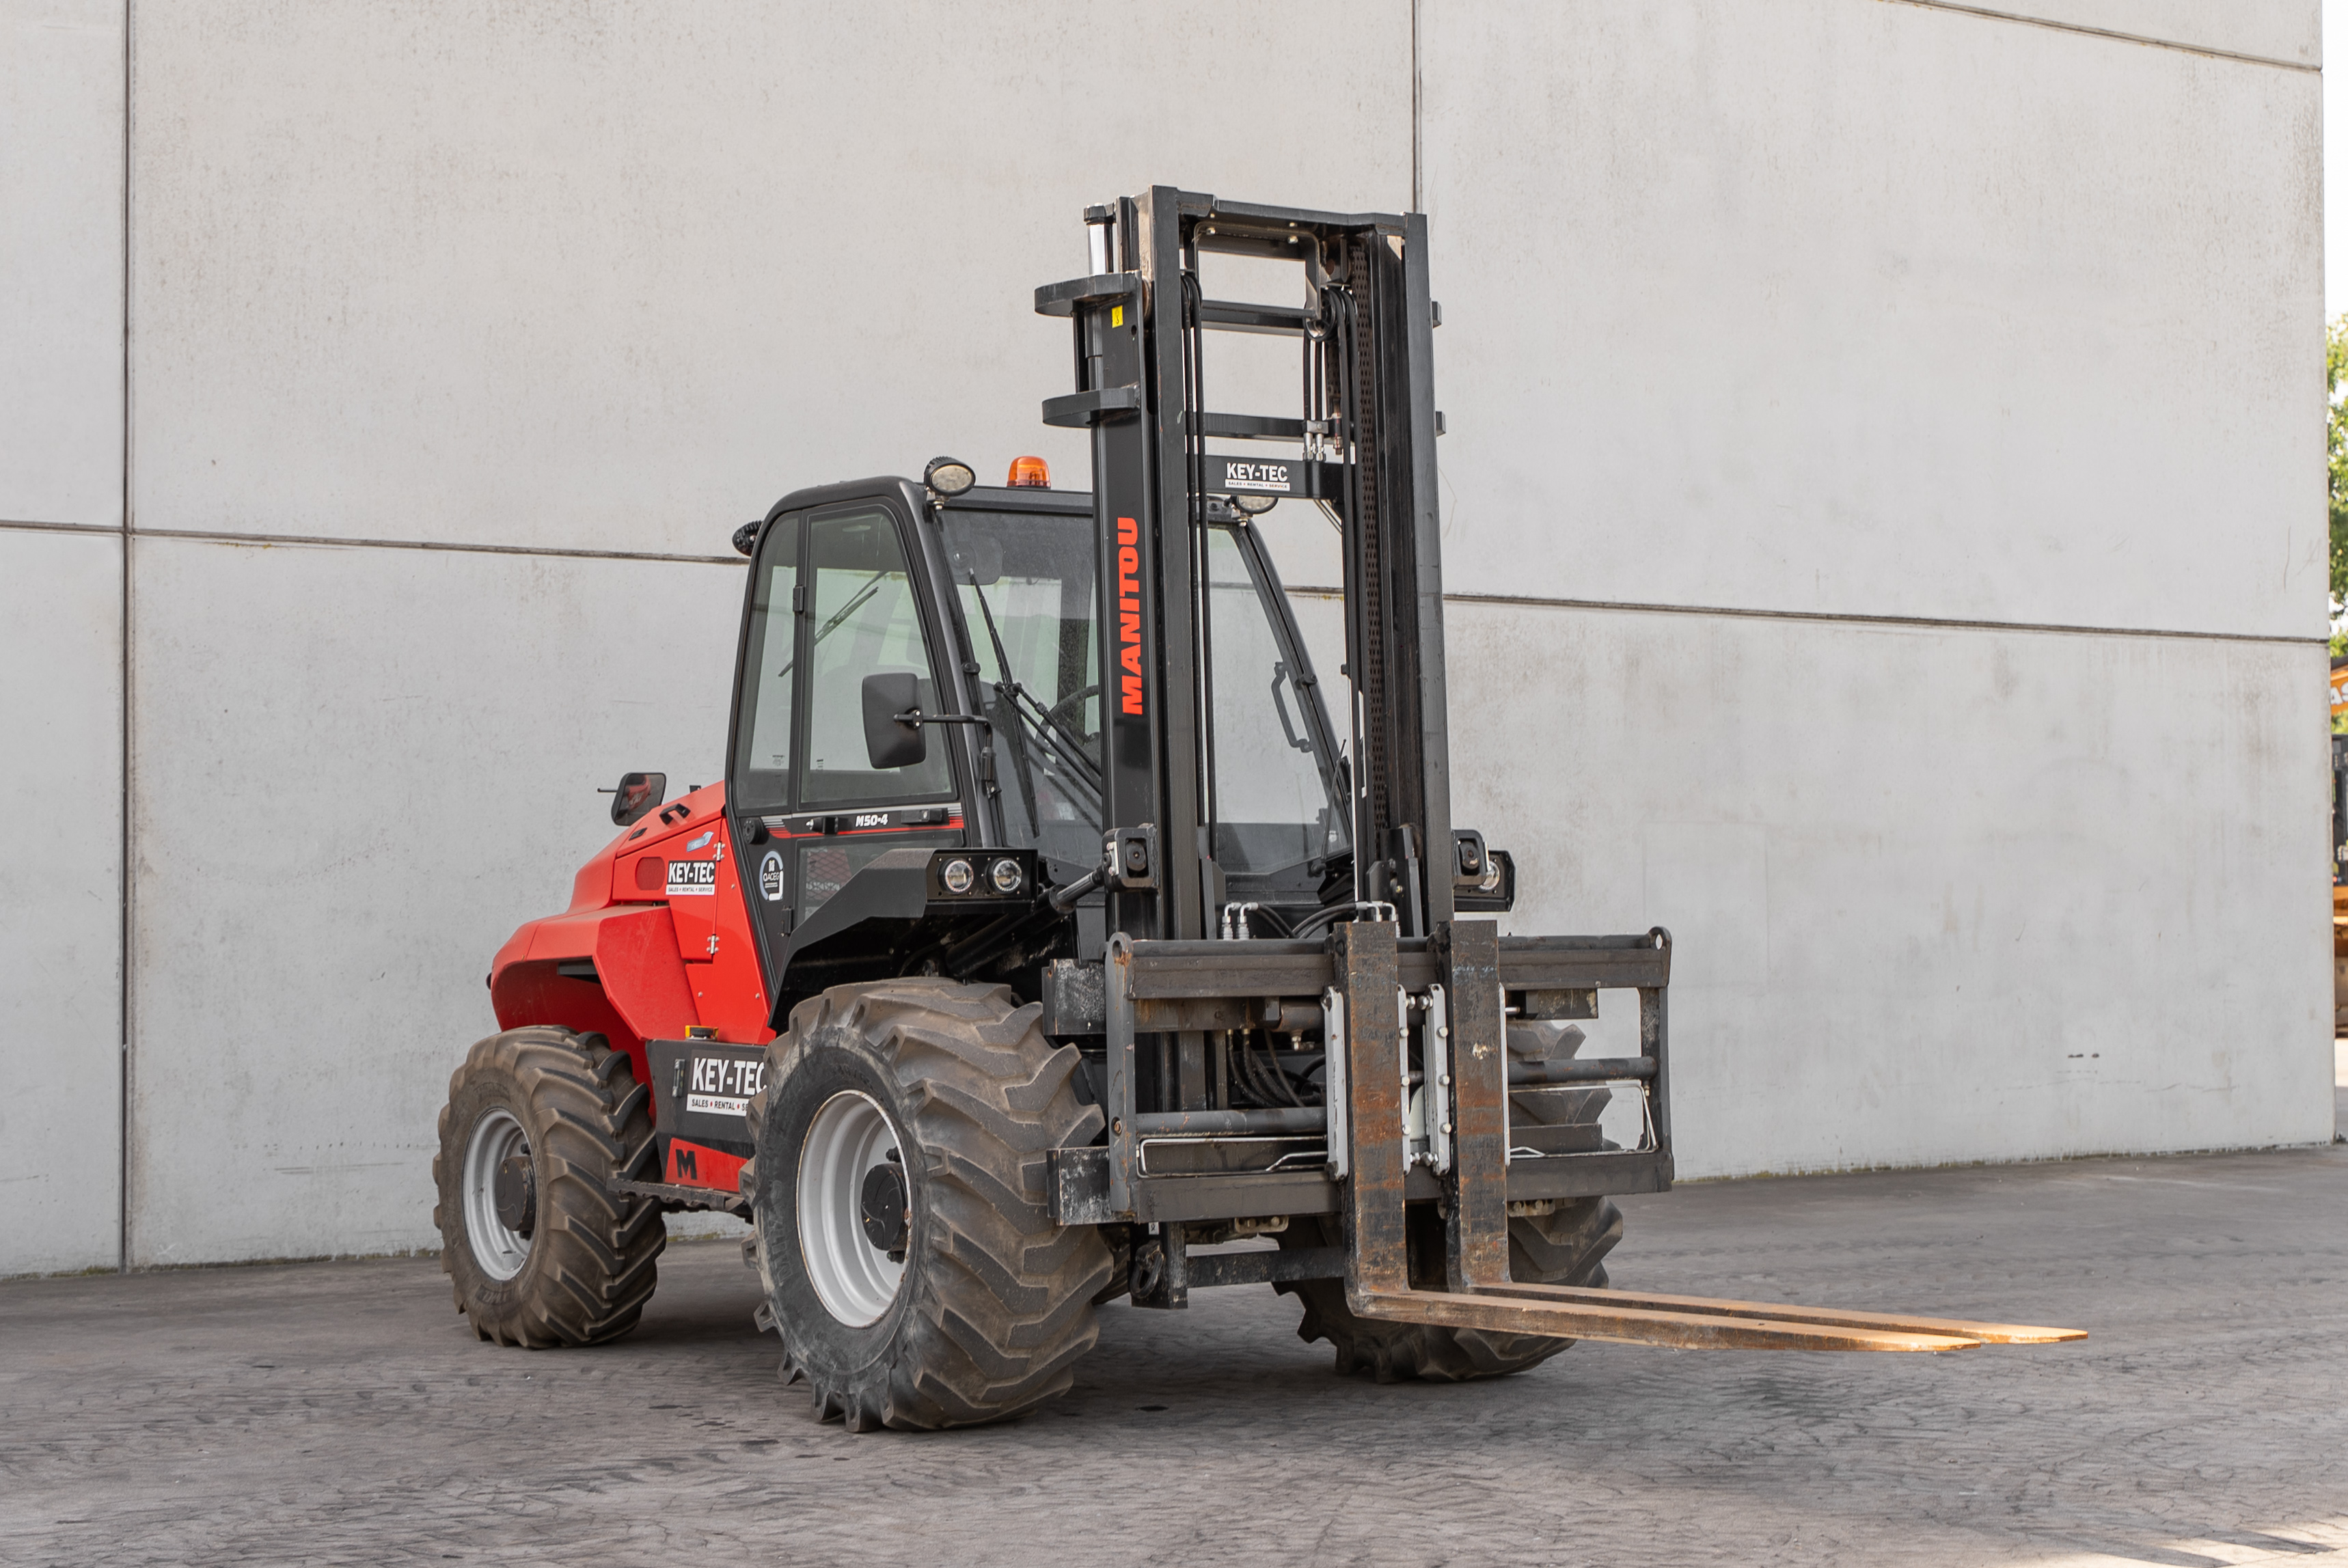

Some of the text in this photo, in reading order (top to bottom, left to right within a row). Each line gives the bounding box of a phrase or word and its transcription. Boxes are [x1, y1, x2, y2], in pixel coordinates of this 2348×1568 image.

[1227, 463, 1288, 482] KEY-TEC
[1117, 517, 1143, 715] MANITOU
[668, 862, 715, 883] KEY-TEC
[692, 1058, 767, 1095] KEY-TEC
[692, 1099, 709, 1108] SALES
[714, 1101, 735, 1110] RENTAL
[675, 1149, 698, 1181] M
